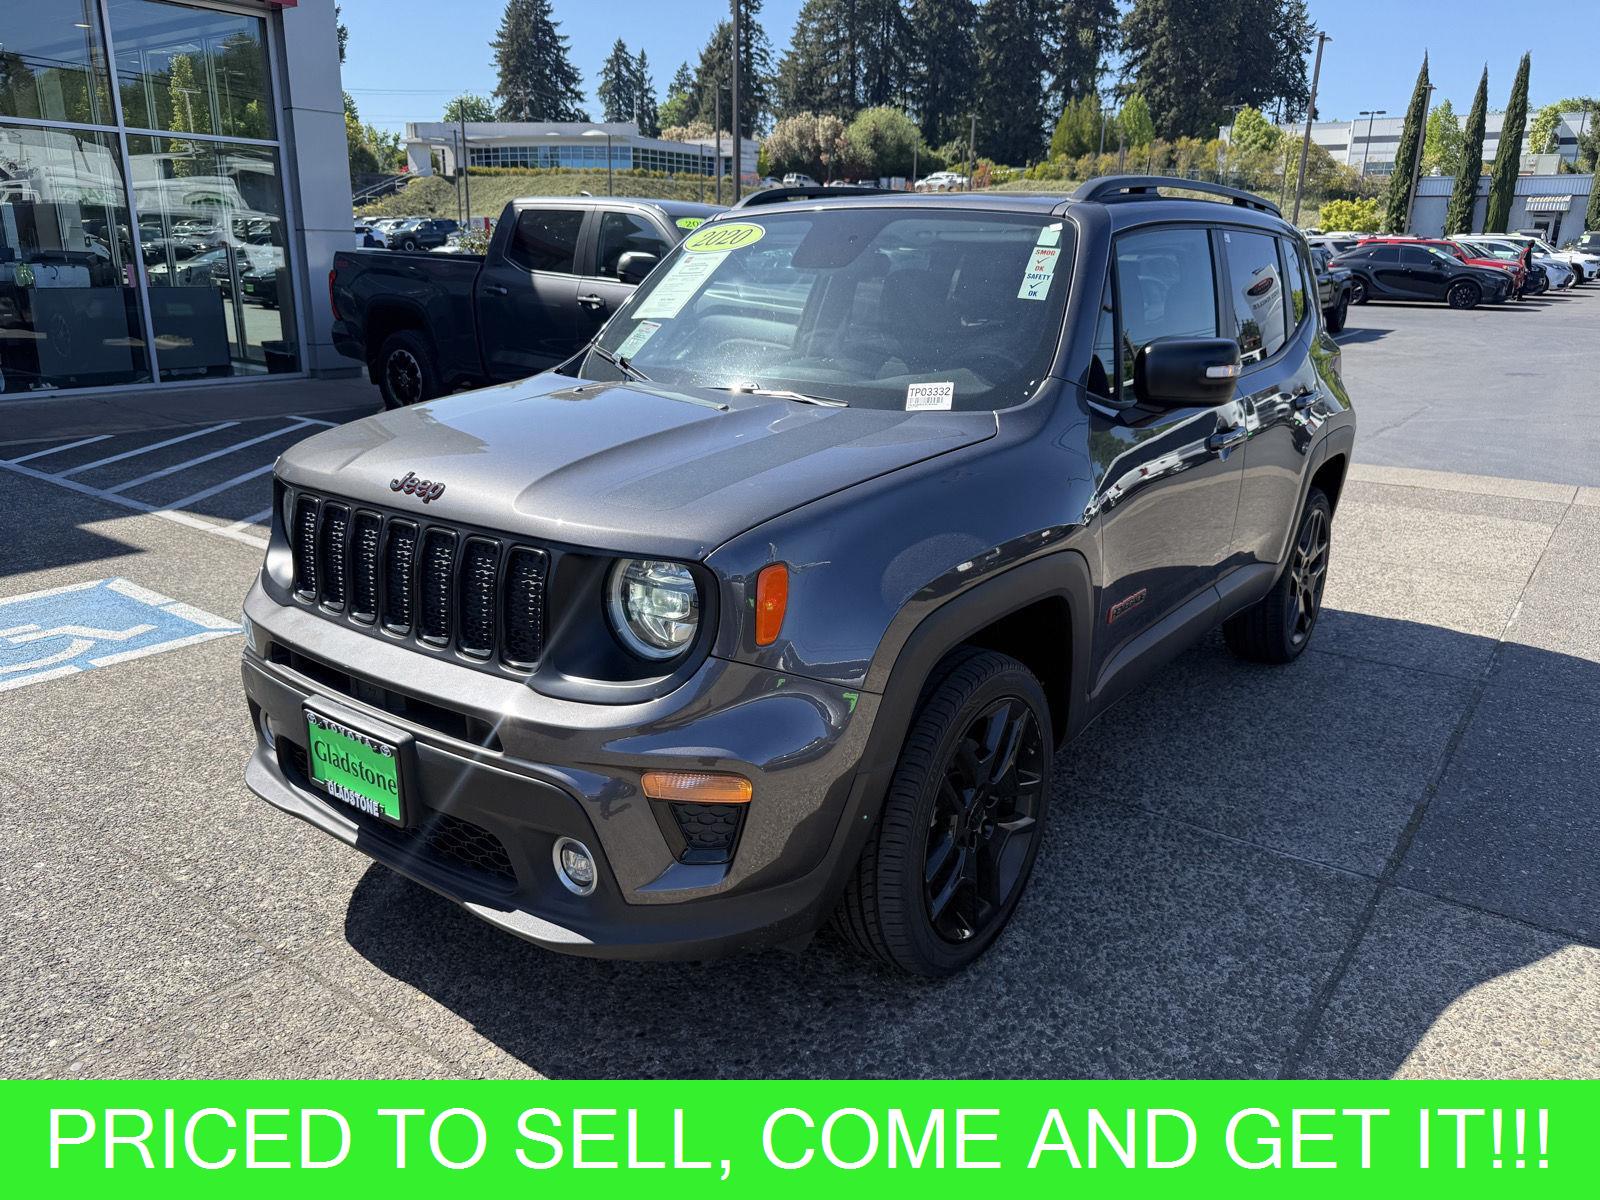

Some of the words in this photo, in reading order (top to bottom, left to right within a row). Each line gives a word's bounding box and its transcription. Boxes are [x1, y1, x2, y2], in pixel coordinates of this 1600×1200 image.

[691, 229, 753, 247] 2020
[910, 386, 951, 397] TP03332
[389, 471, 446, 504] Jeep
[324, 719, 373, 749] TOYOTA
[314, 738, 398, 795] Gladstone
[327, 780, 380, 817] GLADSTONE
